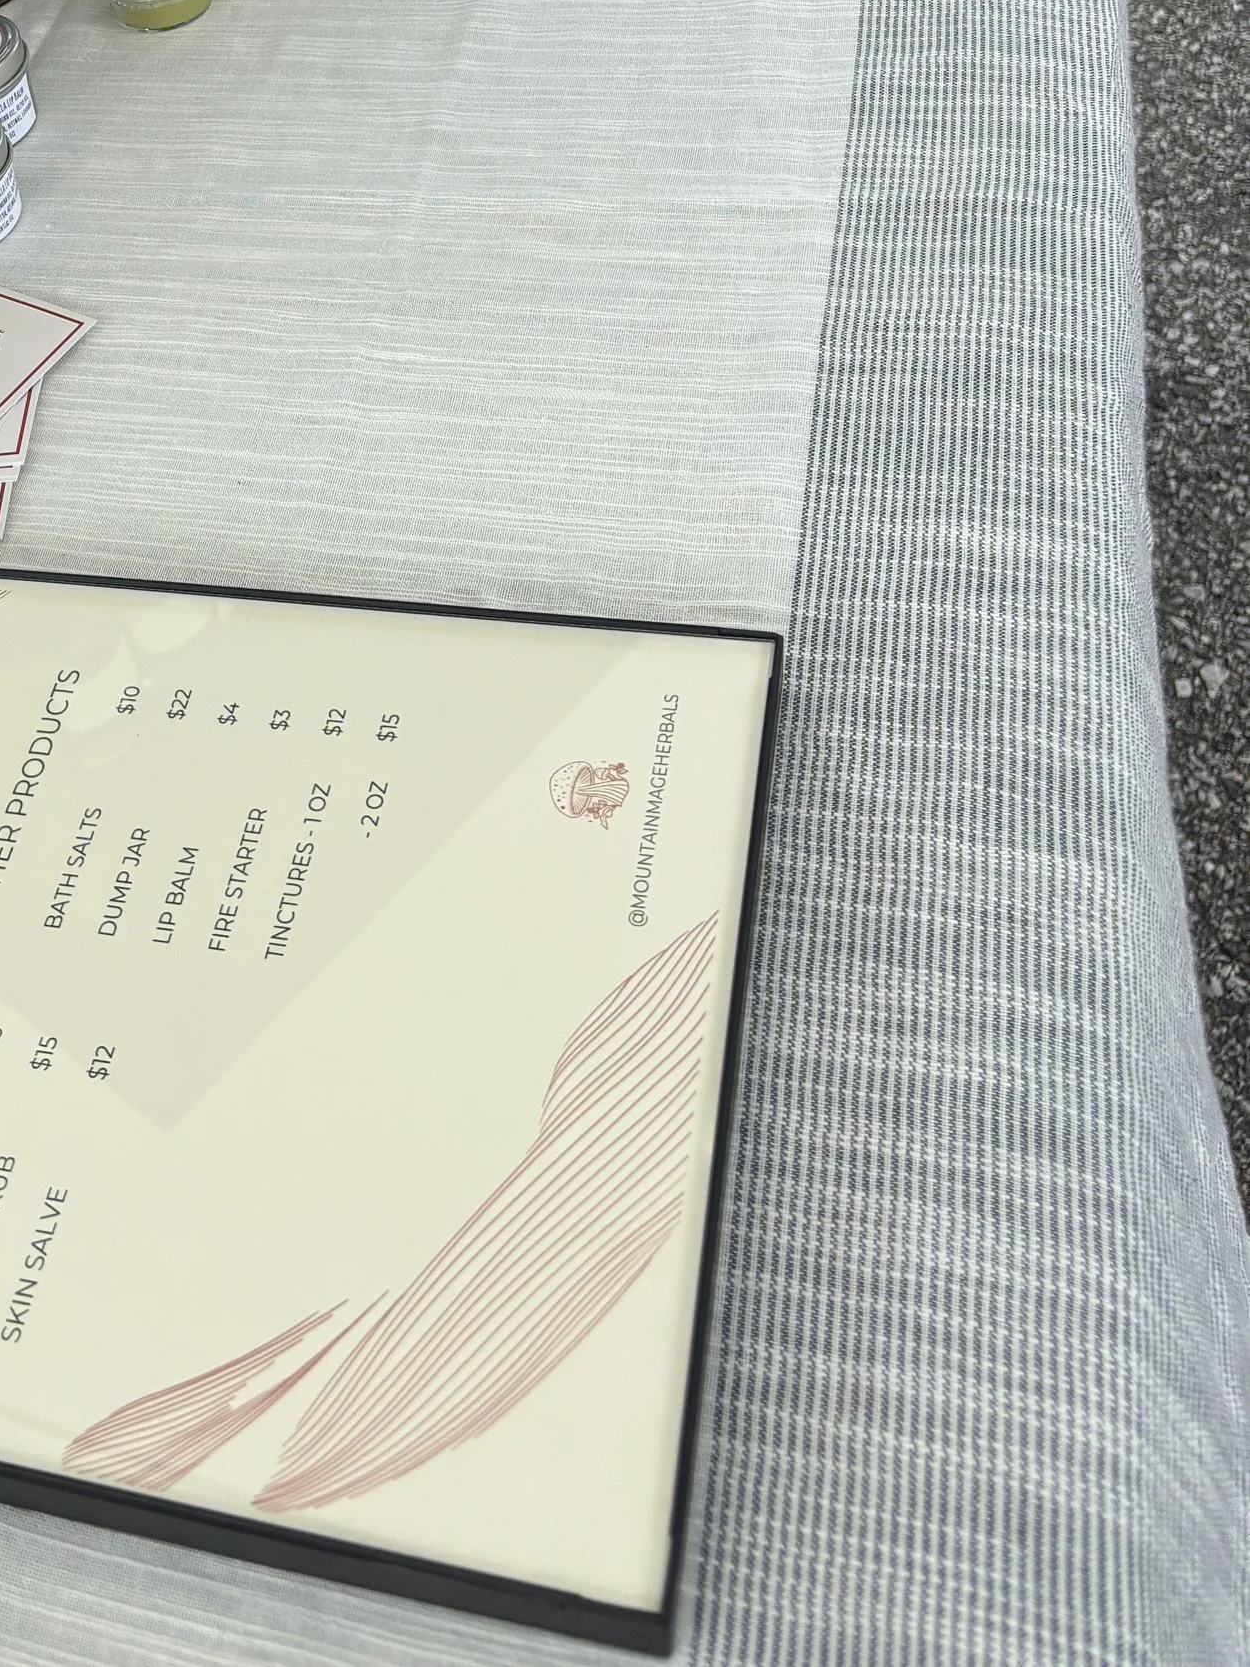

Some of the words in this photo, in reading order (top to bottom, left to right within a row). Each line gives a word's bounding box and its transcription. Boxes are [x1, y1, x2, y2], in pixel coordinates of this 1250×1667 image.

[5, 670, 80, 816] PRODUCTS
[44, 873, 79, 928] BATH
[67, 808, 101, 867] SALTS
[116, 686, 140, 714] $10
[98, 871, 132, 936] DUMP
[122, 828, 150, 867] JAR
[166, 690, 192, 720] $22
[152, 912, 176, 943] LIP
[165, 847, 199, 905] BALM
[217, 703, 239, 725] $4
[208, 904, 238, 951] FIRE
[225, 809, 267, 899] STARTER
[269, 710, 291, 730] $3
[264, 843, 314, 959] TINCTURES
[308, 784, 331, 812] OZ
[322, 709, 346, 736] $12
[361, 815, 379, 826] 2
[366, 781, 388, 809] OZ
[375, 714, 400, 742] $15
[628, 695, 679, 927] @MOUNTAINMAGEHERBALS
[29, 1037, 57, 1071] $15
[1, 1278, 38, 1343] SKIN
[25, 1187, 68, 1270] SALVE
[86, 1046, 115, 1080] $12
